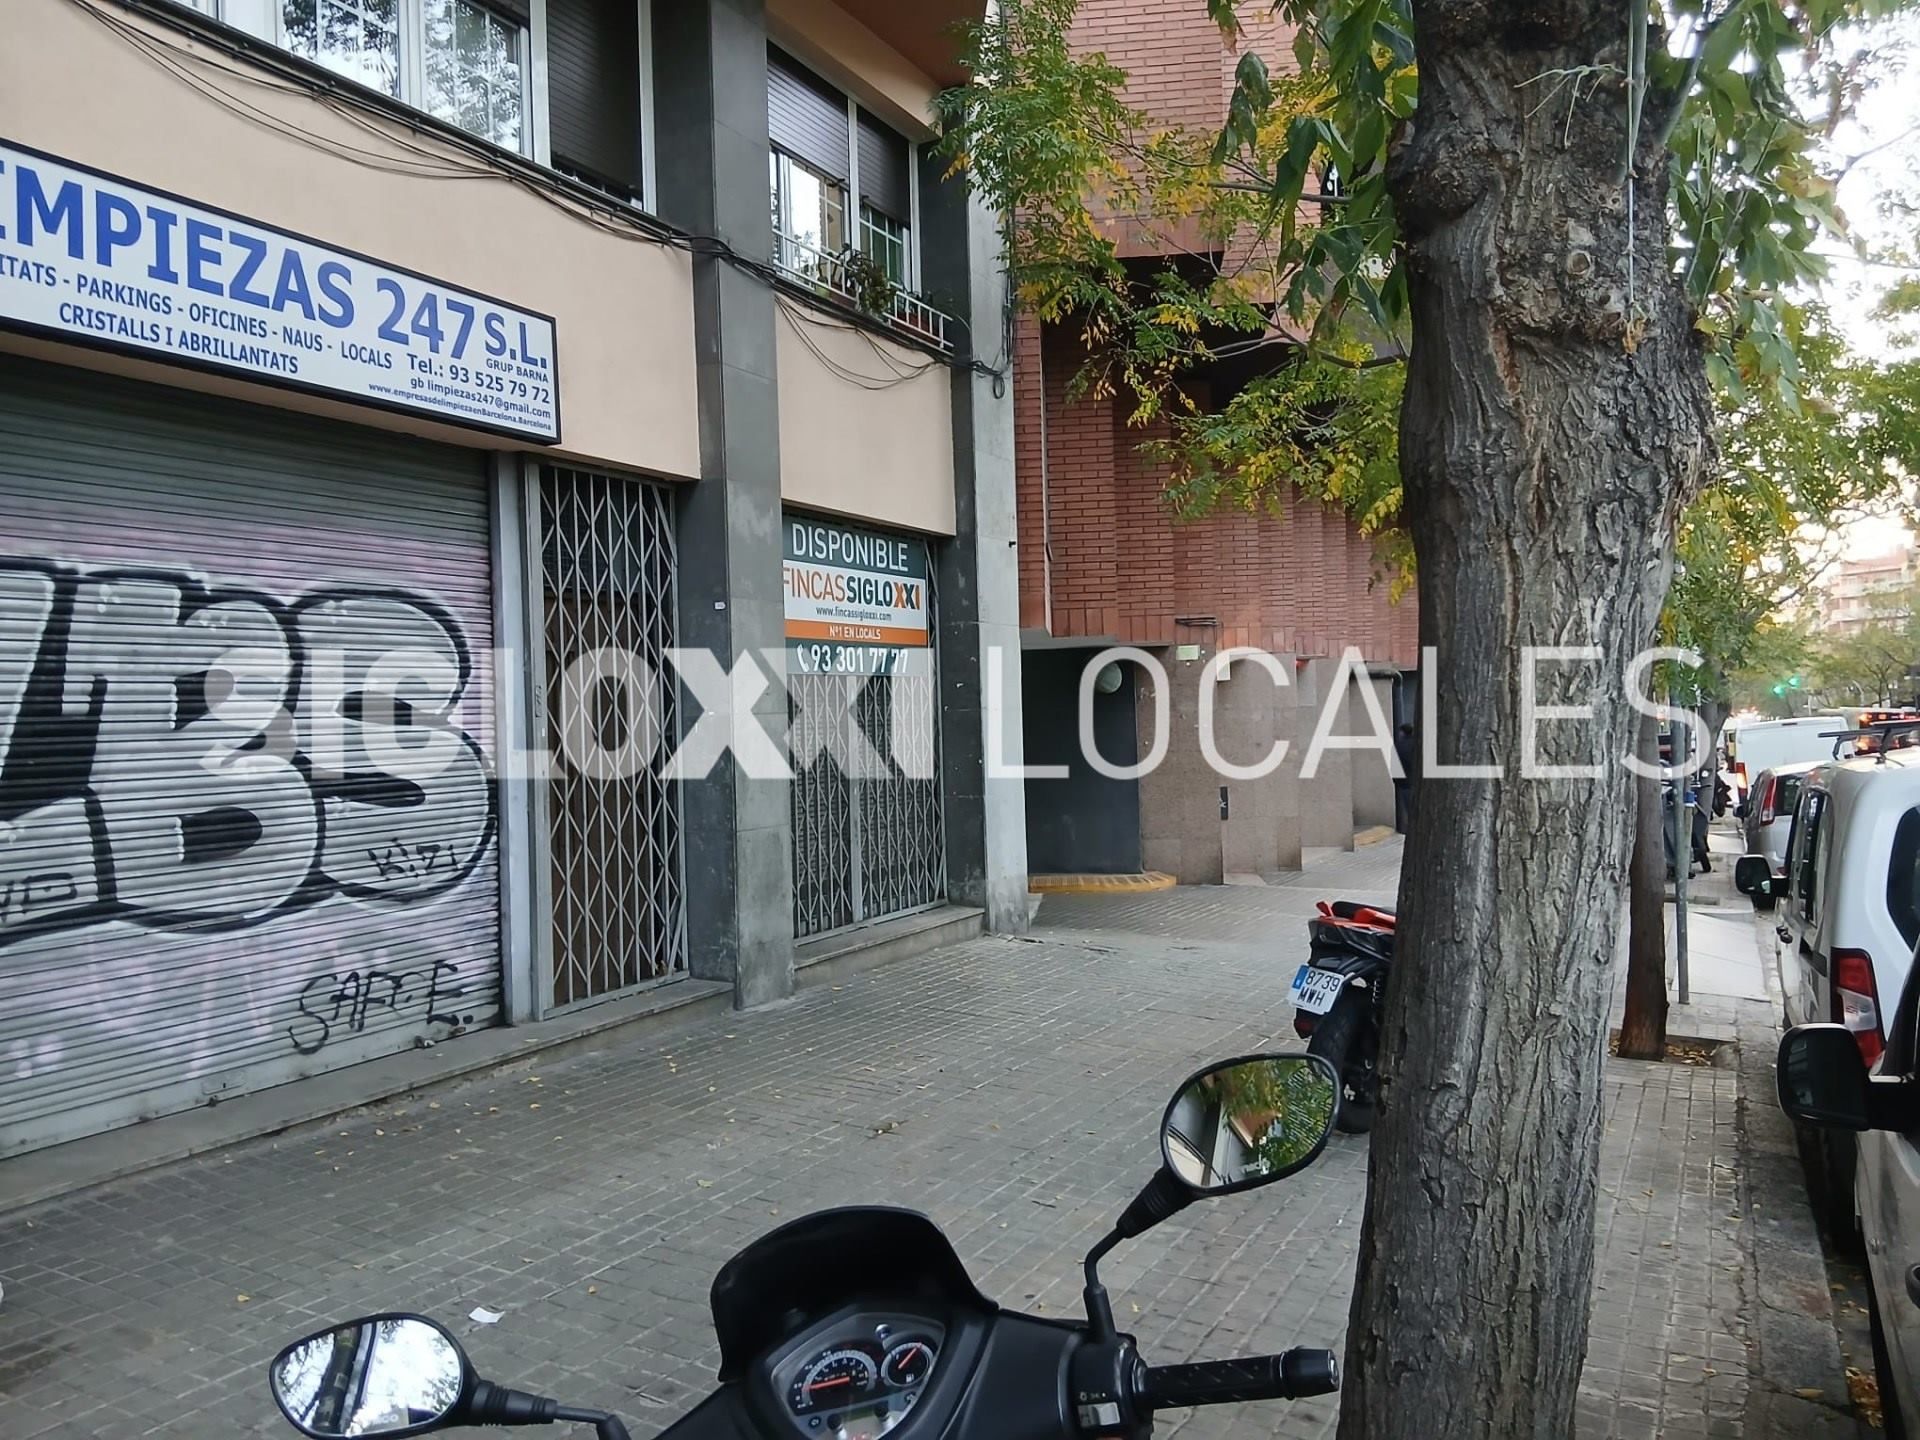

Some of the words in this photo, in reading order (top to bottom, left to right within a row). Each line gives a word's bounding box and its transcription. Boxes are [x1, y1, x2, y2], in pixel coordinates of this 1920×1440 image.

[0, 160, 355, 329] MPIEZAS
[376, 277, 475, 360] 247
[484, 312, 547, 369] S.L.
[59, 302, 160, 343] CRISTALLS
[165, 327, 173, 345] I
[178, 330, 298, 374] ABRILLANTATS
[77, 273, 172, 315] PARKINGS
[189, 303, 267, 338] OFICINES
[282, 326, 322, 352] NAUS
[341, 341, 392, 369] LOCALS
[407, 353, 444, 377] Tel.:
[449, 365, 469, 384] 93
[475, 370, 504, 393] 525
[509, 380, 527, 398] 79
[532, 386, 551, 405] 72
[486, 358, 514, 373] GRUP
[516, 367, 549, 383] BARNA
[410, 377, 425, 390] gb
[427, 378, 551, 419] limpiezas247@gmail.com
[792, 523, 909, 572] DISPONIBLE
[816, 605, 892, 621] www.fincassigloxxi.com
[844, 626, 854, 638] EN
[855, 628, 881, 639] LOCALS
[810, 644, 832, 672] 93
[836, 646, 864, 673] 301
[869, 648, 887, 673] 77
[891, 649, 908, 673] 77
[1305, 970, 1341, 992] 8739
